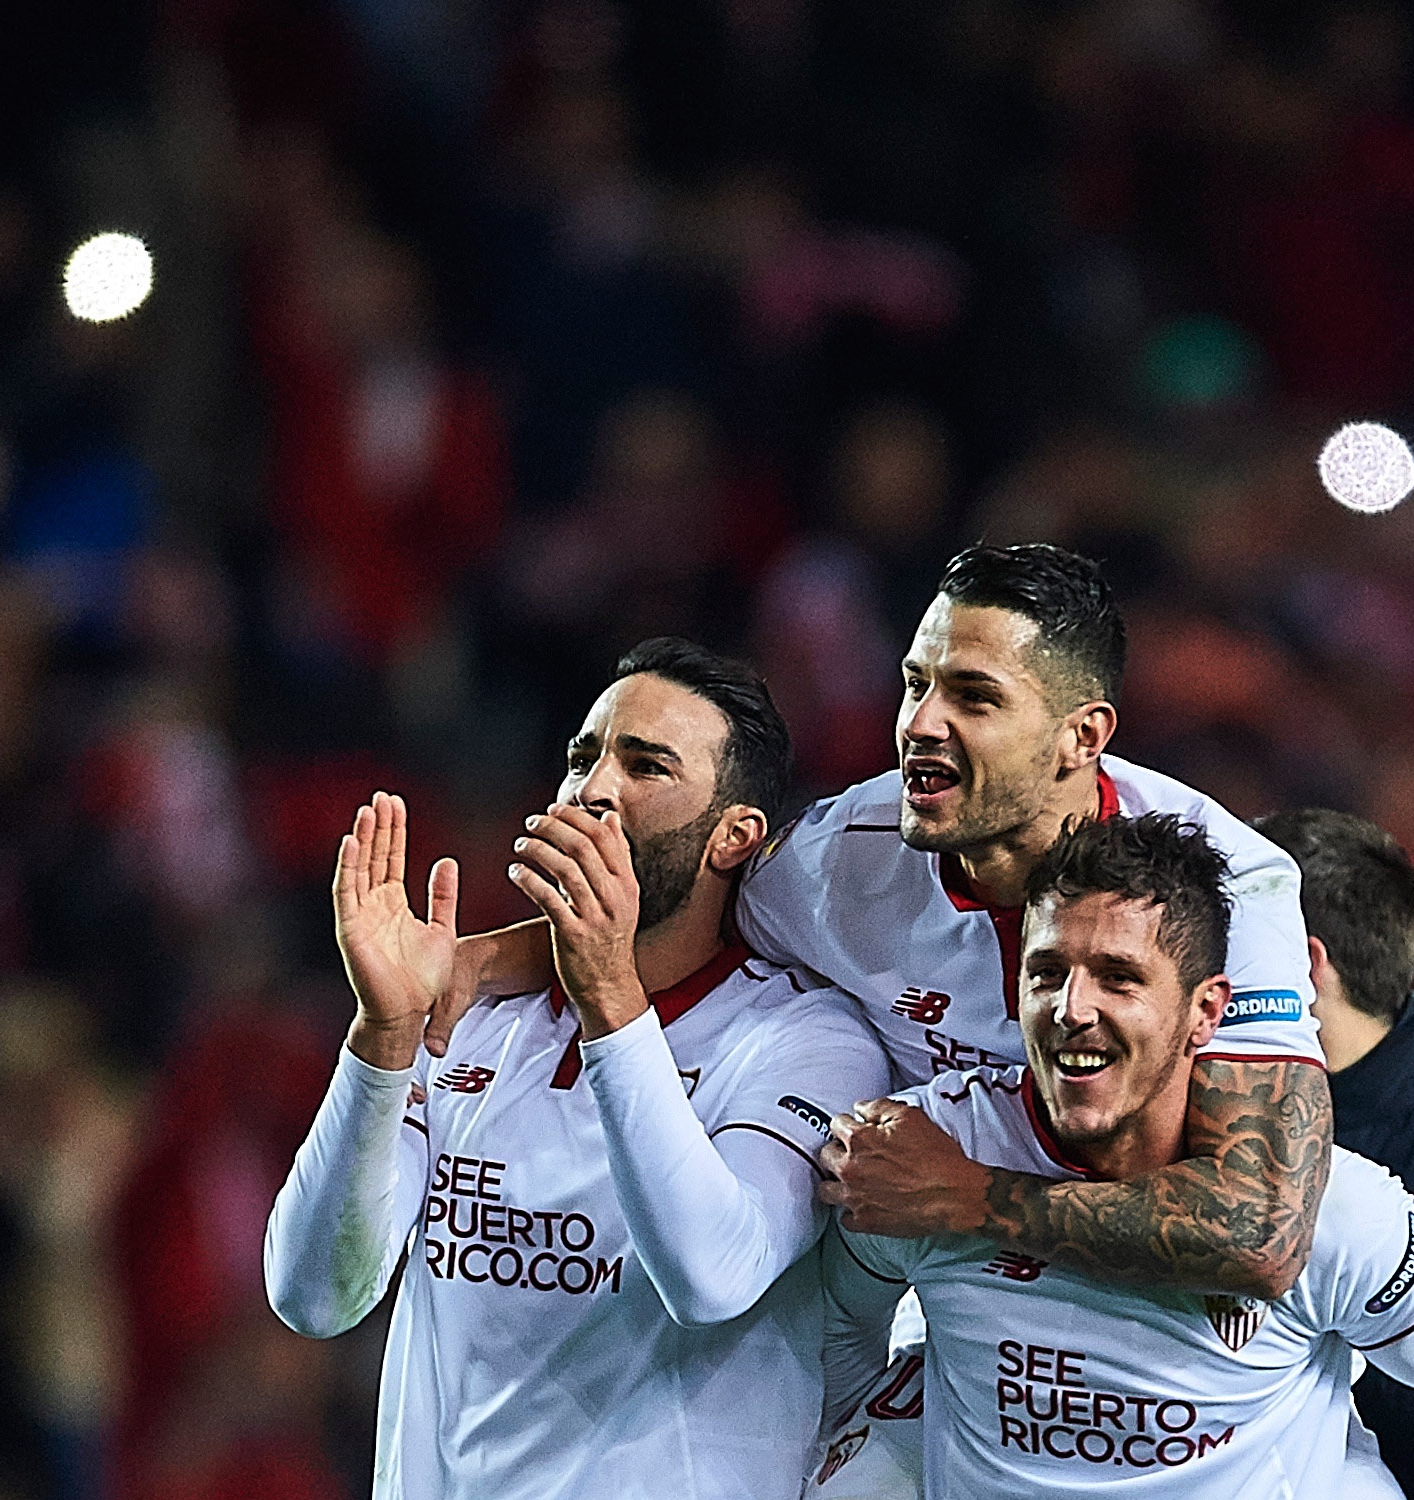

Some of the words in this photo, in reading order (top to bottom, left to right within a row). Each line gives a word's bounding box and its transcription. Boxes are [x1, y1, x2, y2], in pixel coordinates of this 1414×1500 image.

[1224, 997, 1301, 1018] ORDIALITY
[431, 1153, 506, 1201] SEE
[425, 1196, 595, 1252] PUERTO
[425, 1239, 624, 1295] RICO.COM
[997, 1340, 1086, 1388] SEE
[997, 1378, 1197, 1433] PUERTO
[999, 1414, 1236, 1468] RICO.COM
